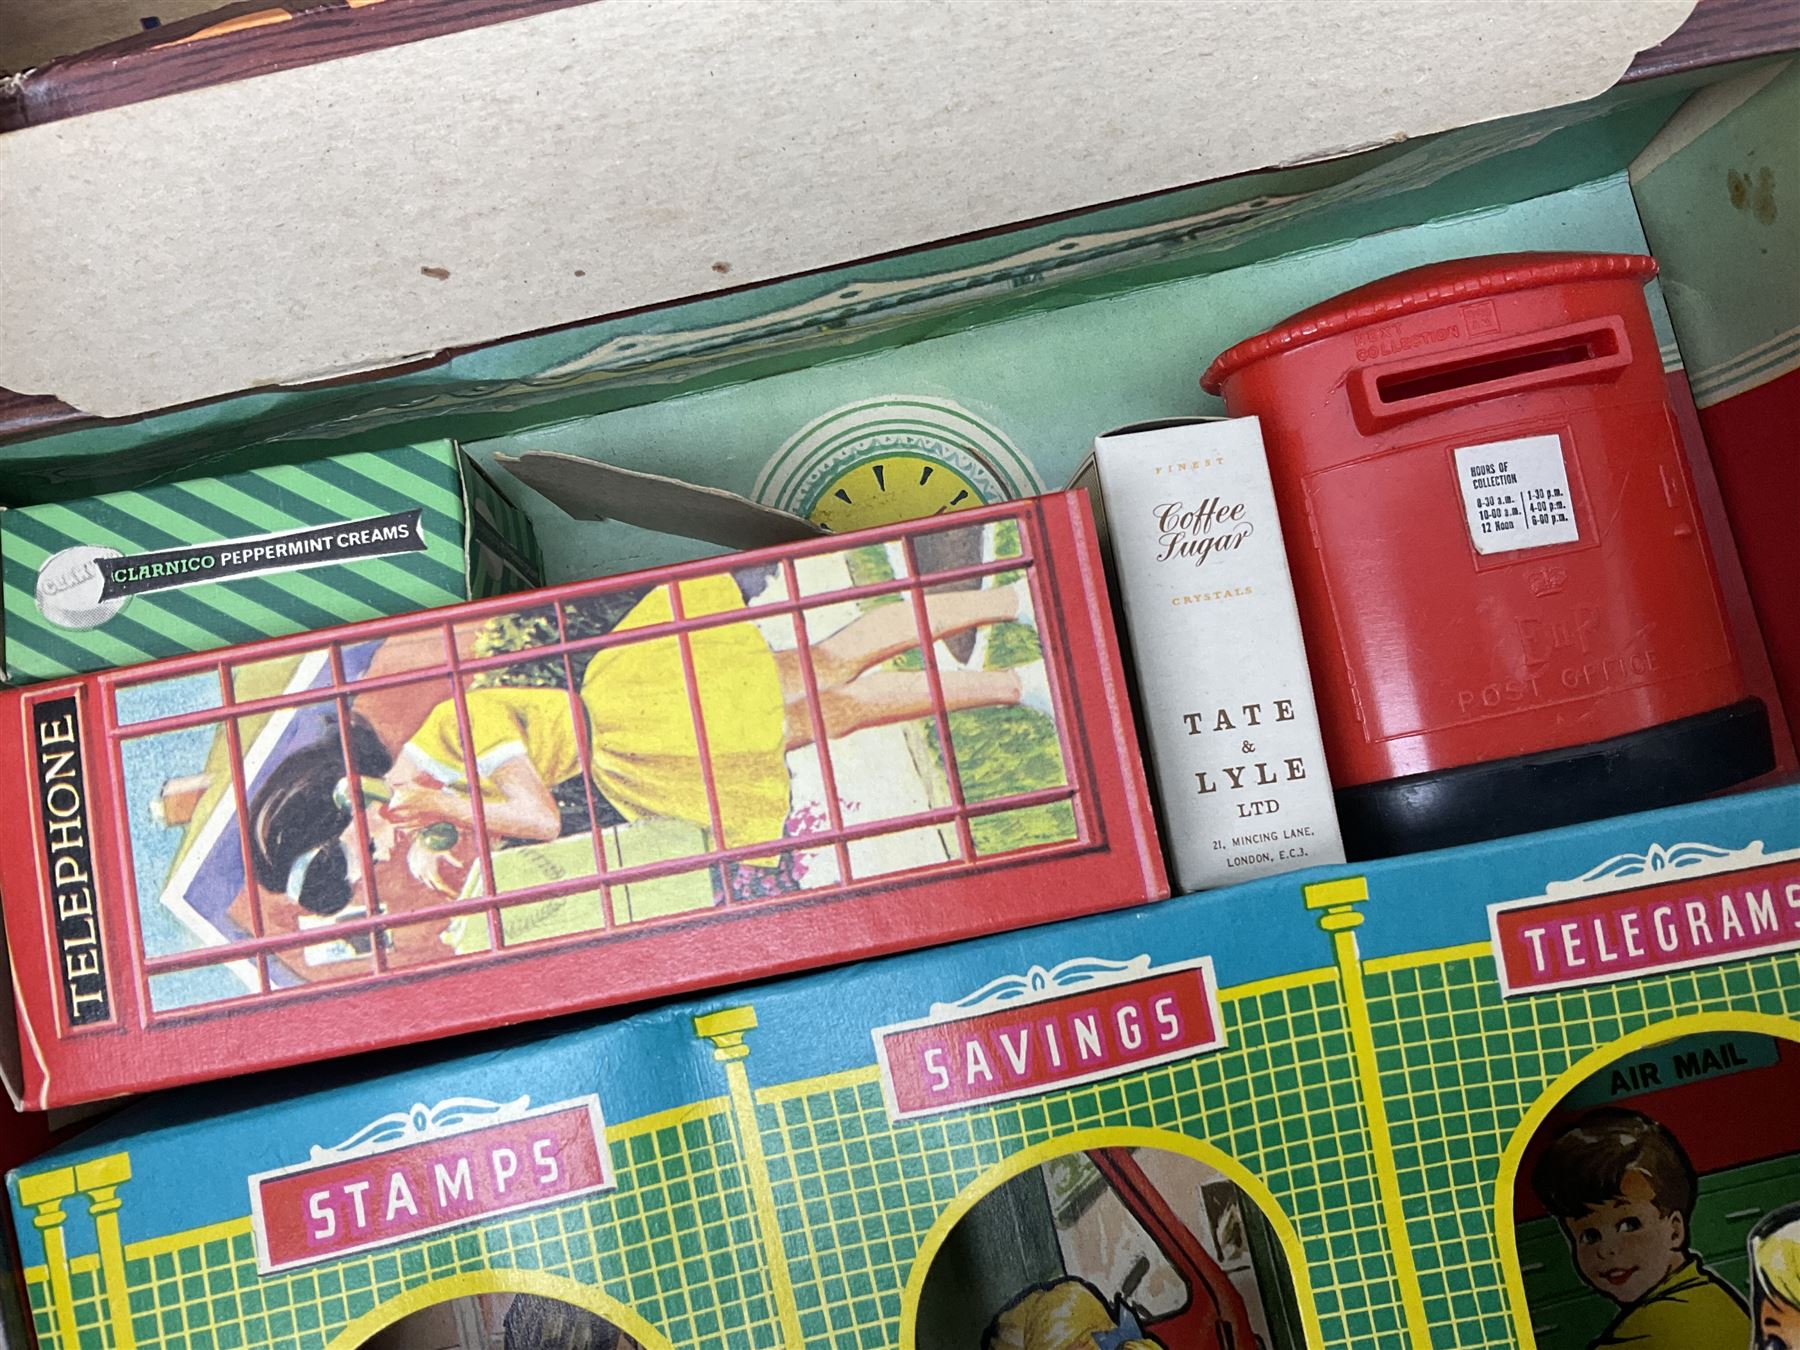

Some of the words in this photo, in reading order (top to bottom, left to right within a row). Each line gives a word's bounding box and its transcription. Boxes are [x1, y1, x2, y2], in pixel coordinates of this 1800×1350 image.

[1353, 325, 1402, 347] NEXT
[1355, 325, 1460, 362] COLLECTION
[1155, 457, 1225, 475] FINEST
[1470, 463, 1496, 477] HOURS
[1498, 461, 1509, 473] OF
[1472, 473, 1518, 490] COLLECTION
[1476, 496, 1495, 508] 8-30
[1497, 496, 1515, 506] a.m.
[1527, 488, 1545, 501] 1-30
[1546, 488, 1564, 500] p.m.
[1153, 496, 1247, 535] Coffee
[1479, 508, 1502, 521] 10-00
[1504, 507, 1522, 517] a.m.
[1529, 501, 1547, 513] 4-00
[1549, 501, 1566, 512] p.m.
[1481, 522, 1492, 533] 12
[1495, 521, 1515, 532] Noon
[1551, 513, 1569, 525] p.m.
[112, 555, 216, 584] CLARNICO
[220, 535, 335, 568] PEPPERMINT
[336, 524, 411, 548] CREAMS
[1156, 521, 1254, 567] Sugar
[1171, 586, 1254, 607] CRYSTALS
[1458, 675, 1540, 713] POST
[1561, 652, 1660, 689] OFFICE
[1183, 699, 1296, 735] TATE
[1241, 740, 1256, 754] &
[1195, 757, 1307, 794] LYLE
[1237, 799, 1281, 818] LTD
[1232, 831, 1279, 848] MINCING
[40, 713, 104, 1018] TELEPHONE
[1524, 884, 1800, 972] TELEGRAMS
[923, 997, 1179, 1092] SAVINGS
[1610, 1062, 1663, 1096] AIR
[1672, 1042, 1749, 1081] MAIL
[309, 1138, 559, 1240] STAMPS
